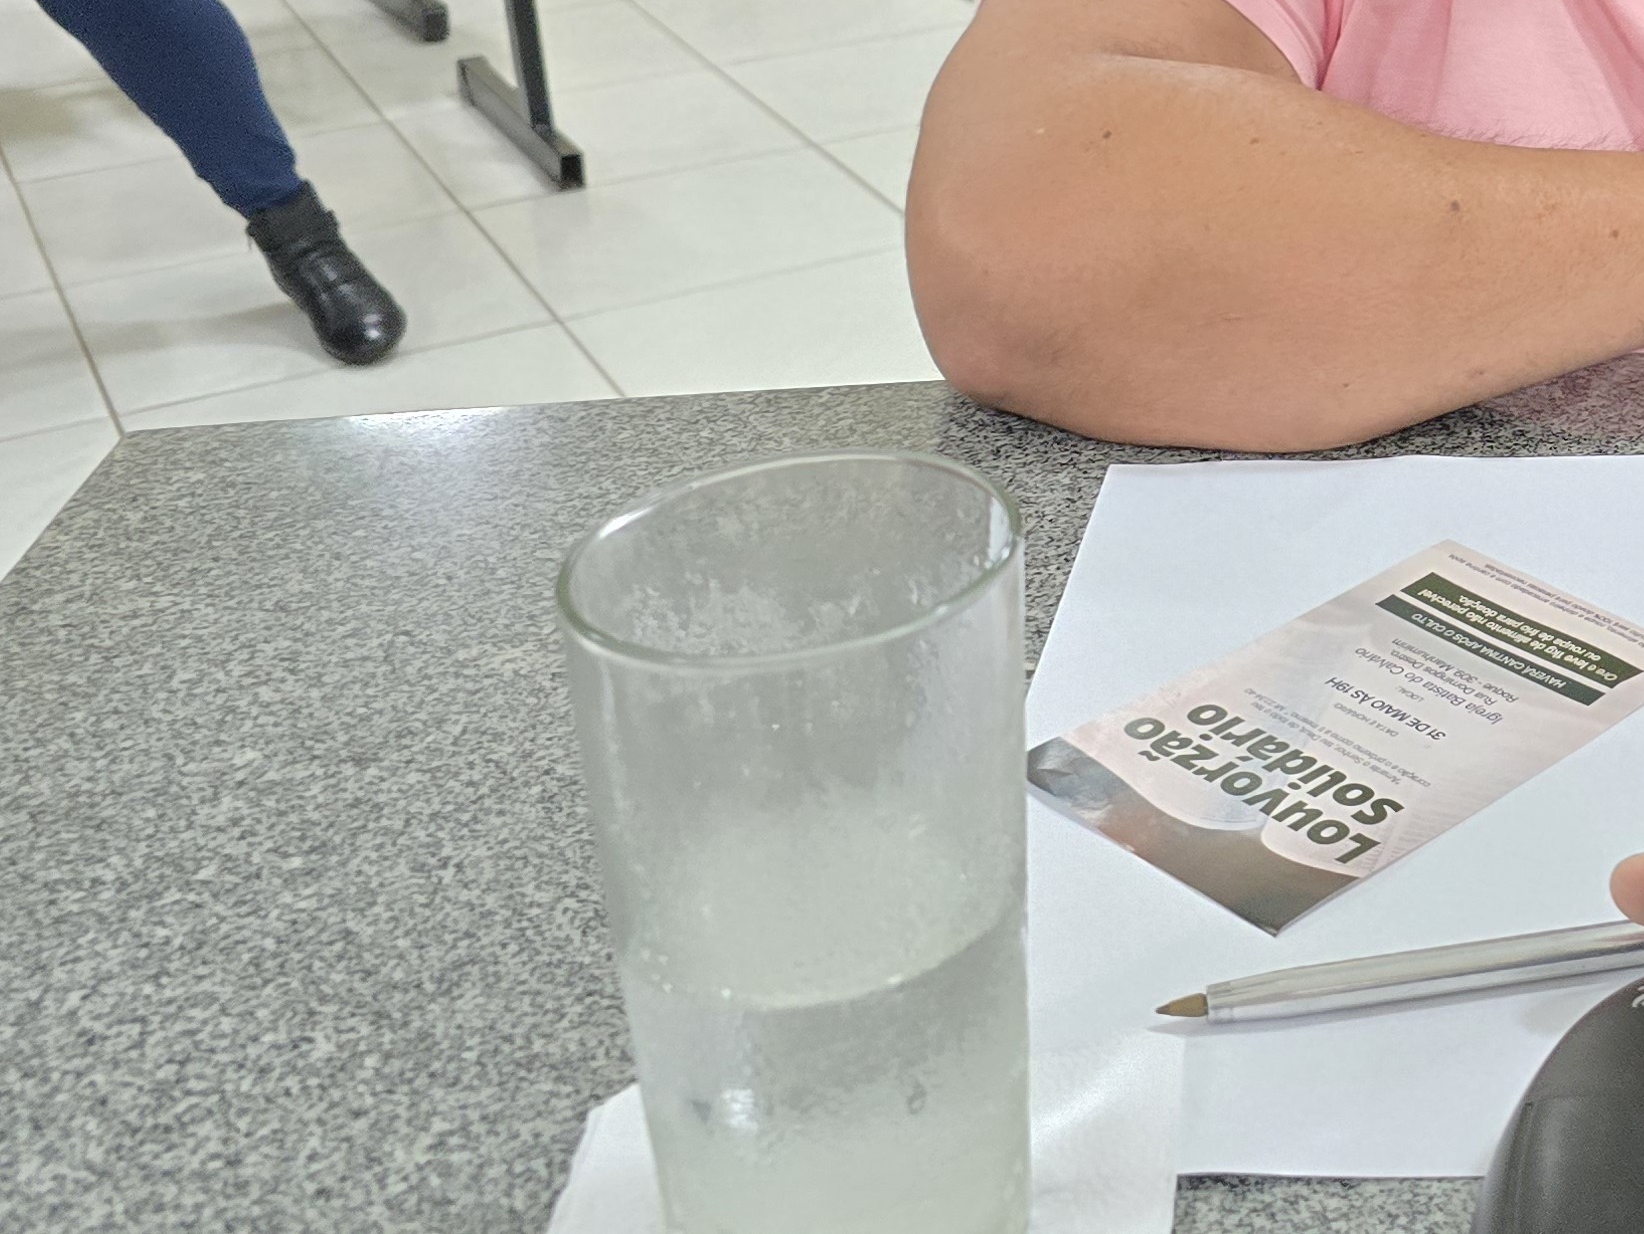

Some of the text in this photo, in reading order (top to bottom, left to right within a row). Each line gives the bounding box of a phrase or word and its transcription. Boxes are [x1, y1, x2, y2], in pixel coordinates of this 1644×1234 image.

[1416, 588, 1470, 615] perecível
[1457, 594, 1602, 662] ou roupa de frio para doação.
[1464, 610, 1489, 625] não
[1484, 618, 1533, 644] alimento
[1528, 638, 1547, 650] de
[1390, 637, 1455, 672] Manhumirim
[1410, 612, 1567, 689] HAVERÁ CANTINA APÓS O CULTO
[1542, 644, 1565, 659] 1kg
[1562, 653, 1590, 670] leve
[1421, 665, 1476, 695] Domingos
[1586, 663, 1597, 671] e
[1353, 646, 1504, 725] Igreja Batista do Calvário
[1394, 684, 1425, 703] LOCAL:
[1472, 690, 1498, 706] Rua
[1484, 683, 1520, 703] Roque
[1323, 675, 1446, 741] 31 DE MAIO ÀS 19H
[1187, 704, 1402, 825] Solidário
[1124, 717, 1378, 863] Louvorzão
